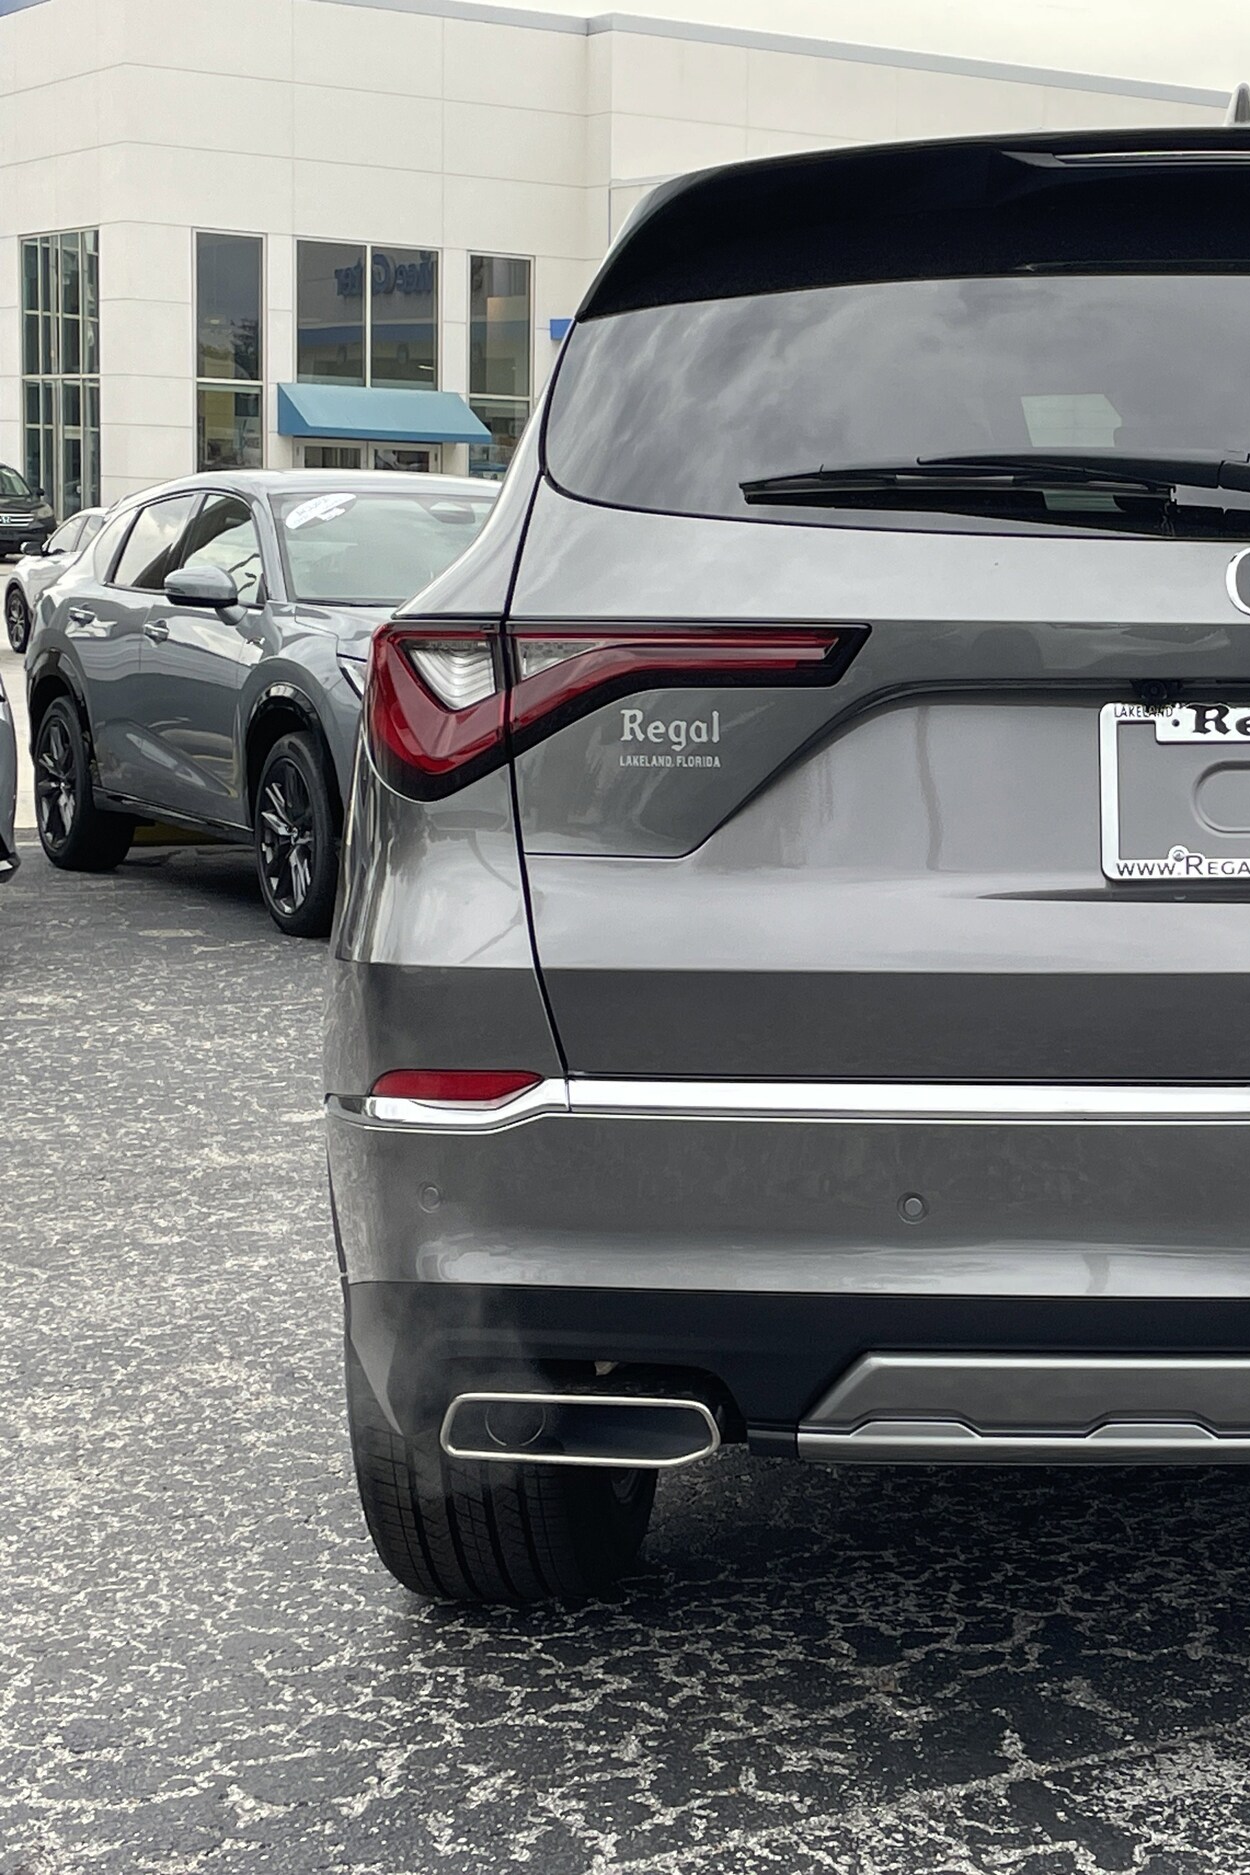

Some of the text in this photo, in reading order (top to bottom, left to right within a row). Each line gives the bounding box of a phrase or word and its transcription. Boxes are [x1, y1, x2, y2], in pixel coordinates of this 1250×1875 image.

[1114, 704, 1174, 718] LAKELAND
[620, 709, 720, 752] Regal
[676, 755, 721, 768] FLORIDA
